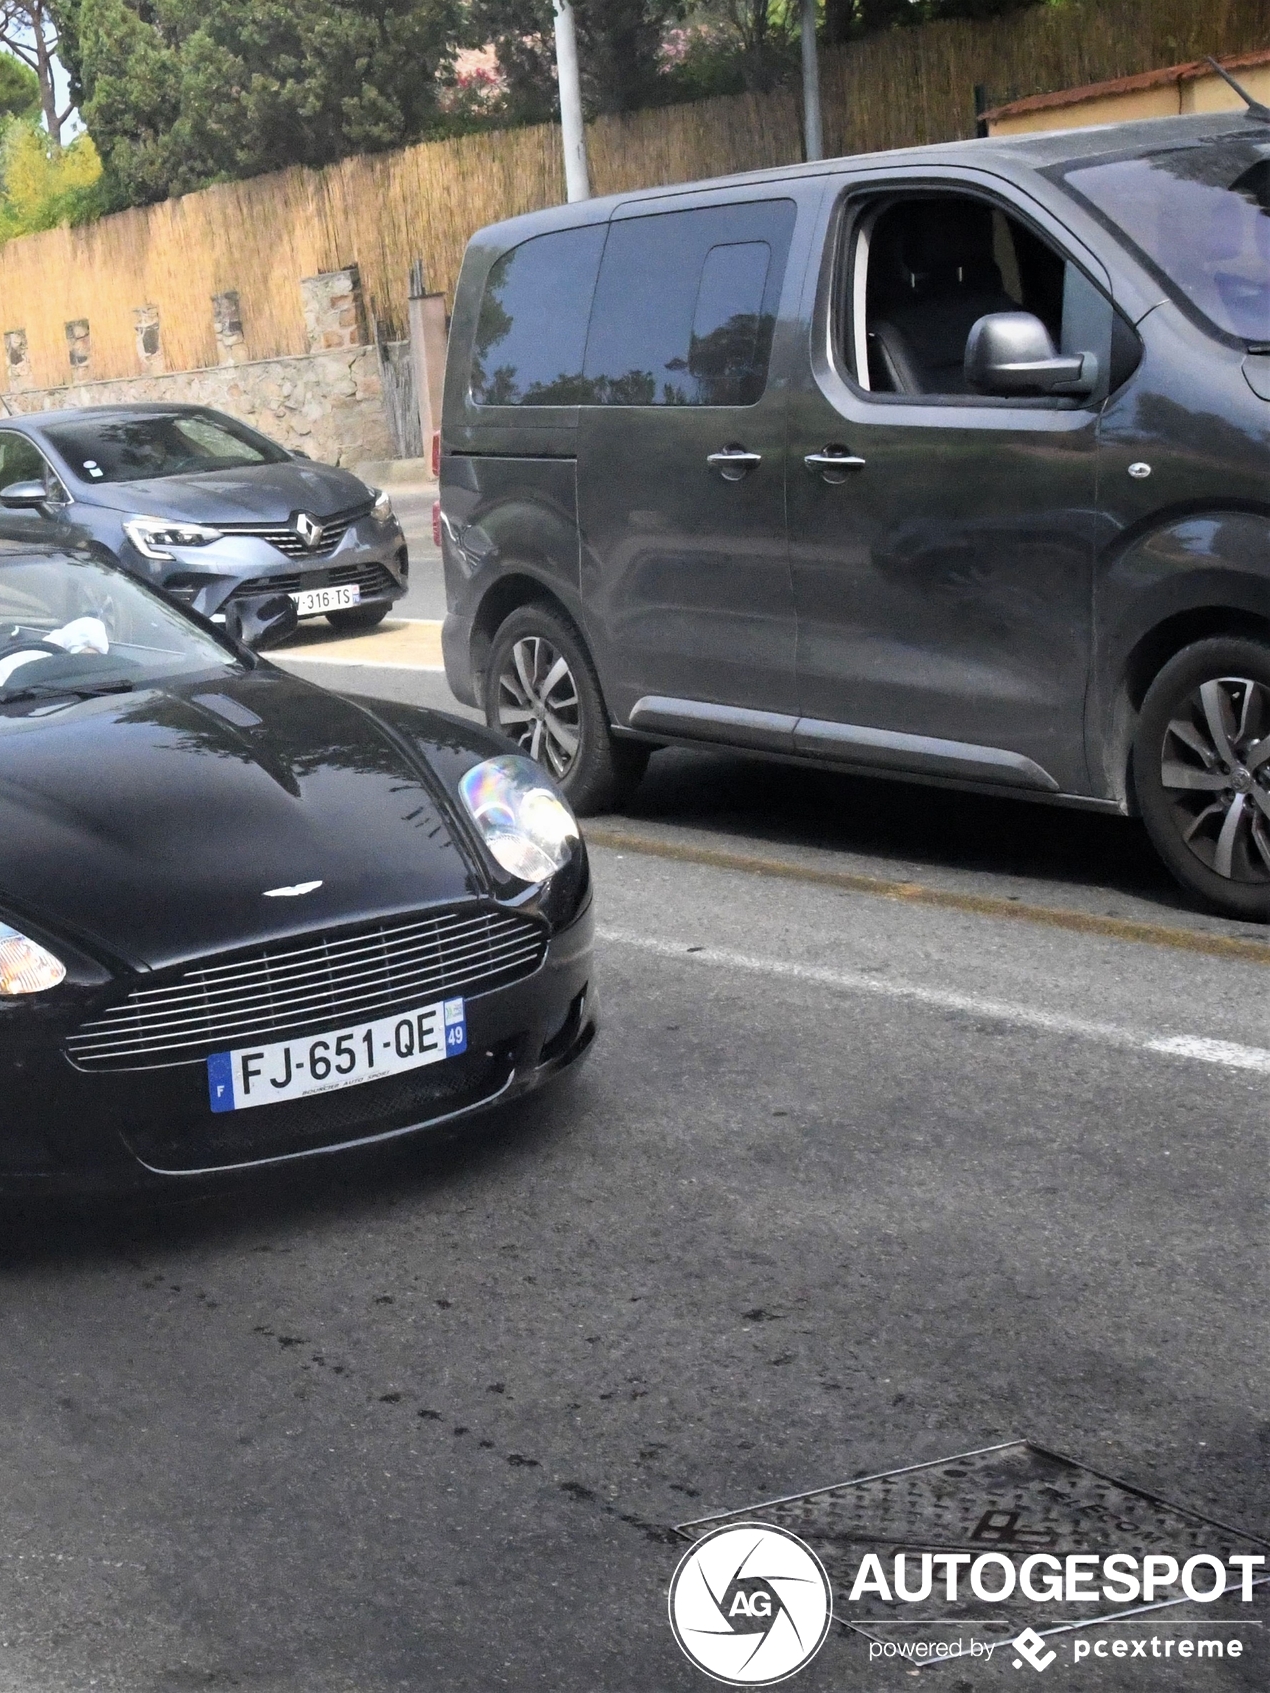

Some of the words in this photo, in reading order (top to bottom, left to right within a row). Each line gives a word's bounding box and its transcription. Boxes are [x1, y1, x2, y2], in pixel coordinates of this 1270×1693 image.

[448, 1025, 463, 1045] 49
[241, 1010, 438, 1095] FJ-651-QE
[343, 1077, 364, 1085] AUTO
[368, 1070, 390, 1080] SPORT
[217, 1085, 225, 1097] F
